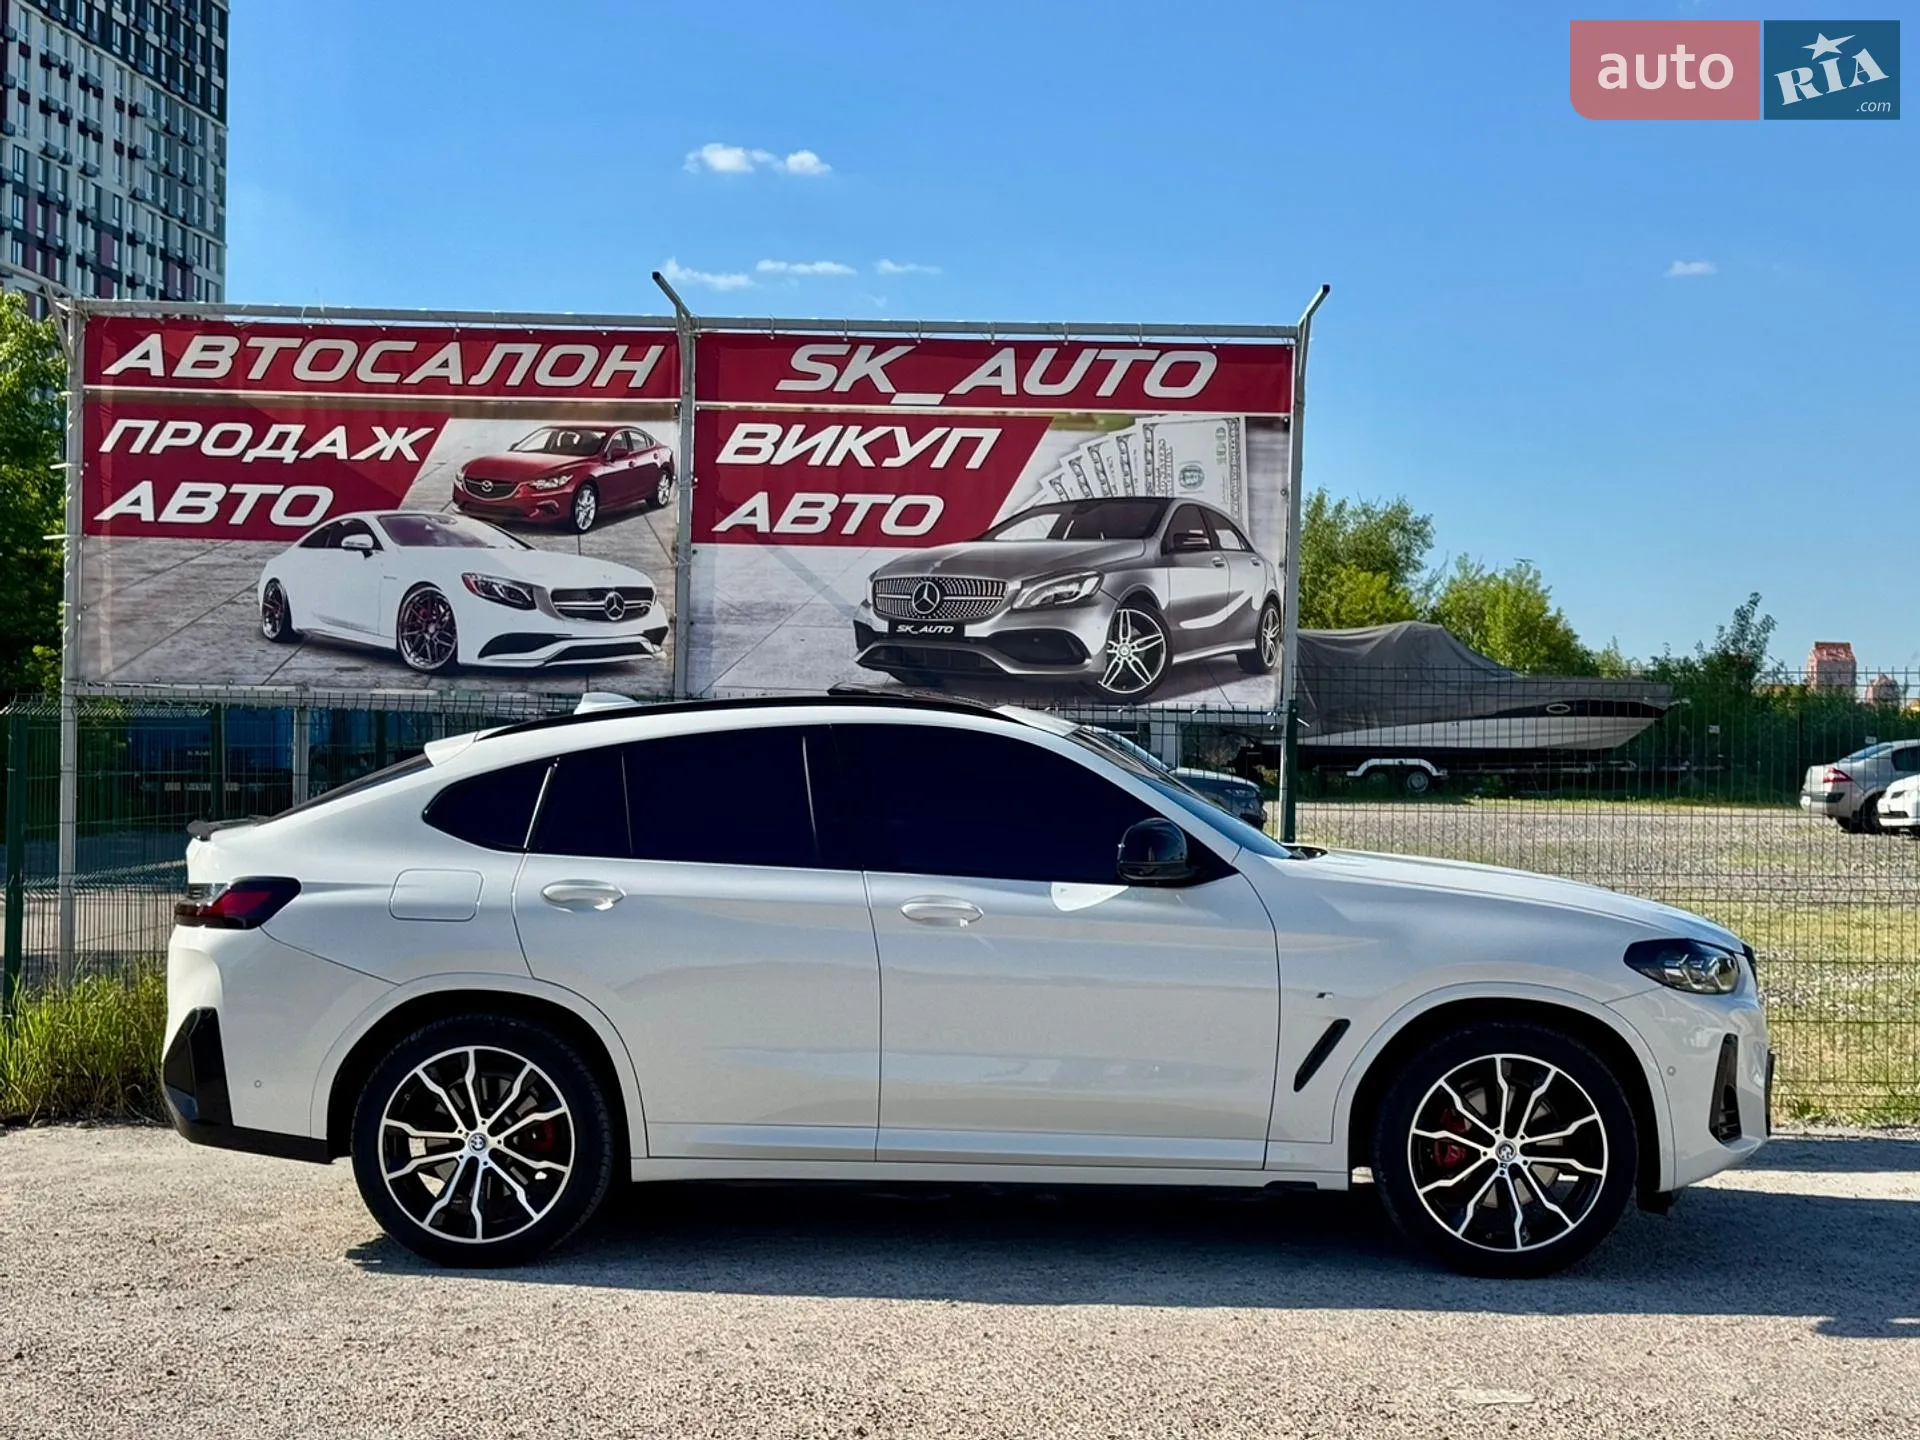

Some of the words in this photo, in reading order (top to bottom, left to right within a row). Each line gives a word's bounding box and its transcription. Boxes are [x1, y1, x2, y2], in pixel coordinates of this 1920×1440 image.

[101, 332, 666, 388] АВТОСАЛОН
[775, 343, 1218, 407] SK_AUTO
[99, 418, 435, 464] ПРОДАЖ
[715, 422, 1003, 470] ВИКУП
[93, 480, 335, 527] АВТО
[711, 492, 945, 536] АВТО
[895, 624, 955, 635] SK_AUTO
